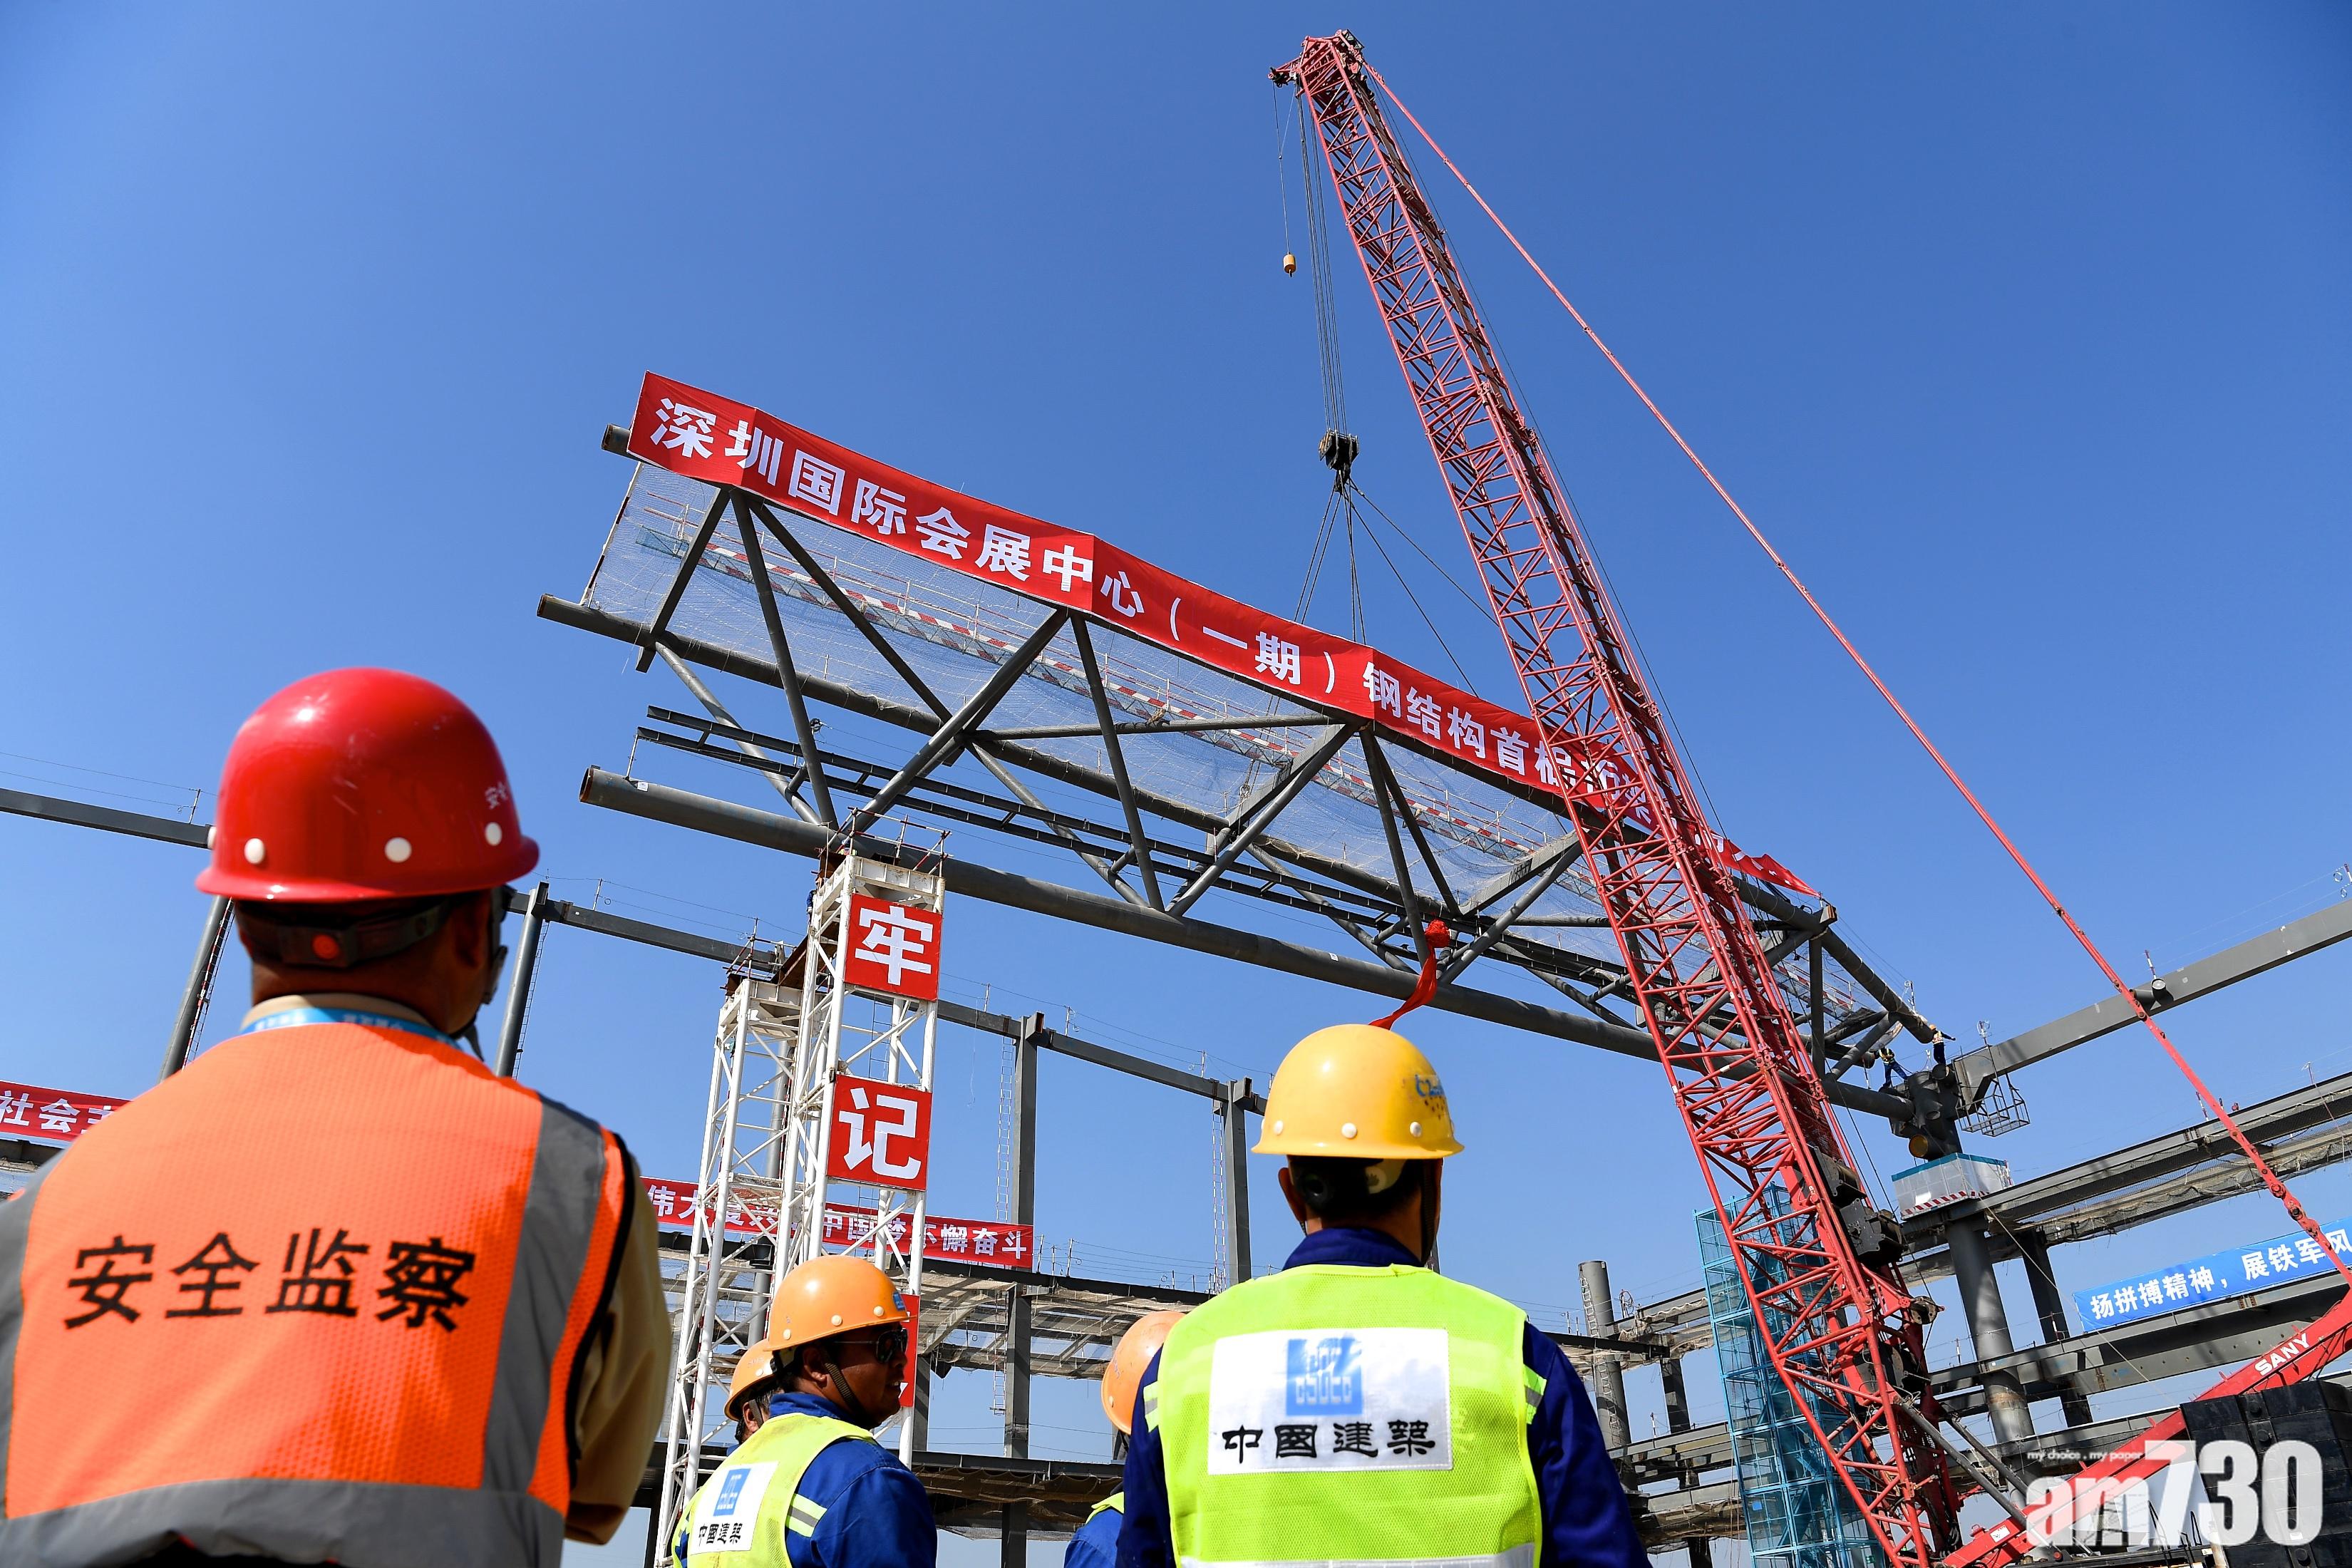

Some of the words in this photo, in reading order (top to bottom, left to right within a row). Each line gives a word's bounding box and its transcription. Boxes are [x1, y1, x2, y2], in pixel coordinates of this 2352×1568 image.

[855, 905, 933, 986] 牢
[838, 1087, 922, 1180] 记
[64, 1228, 476, 1331] 安全监察
[2254, 1332, 2309, 1376] SANY
[1222, 1419, 1435, 1464] 中國建築
